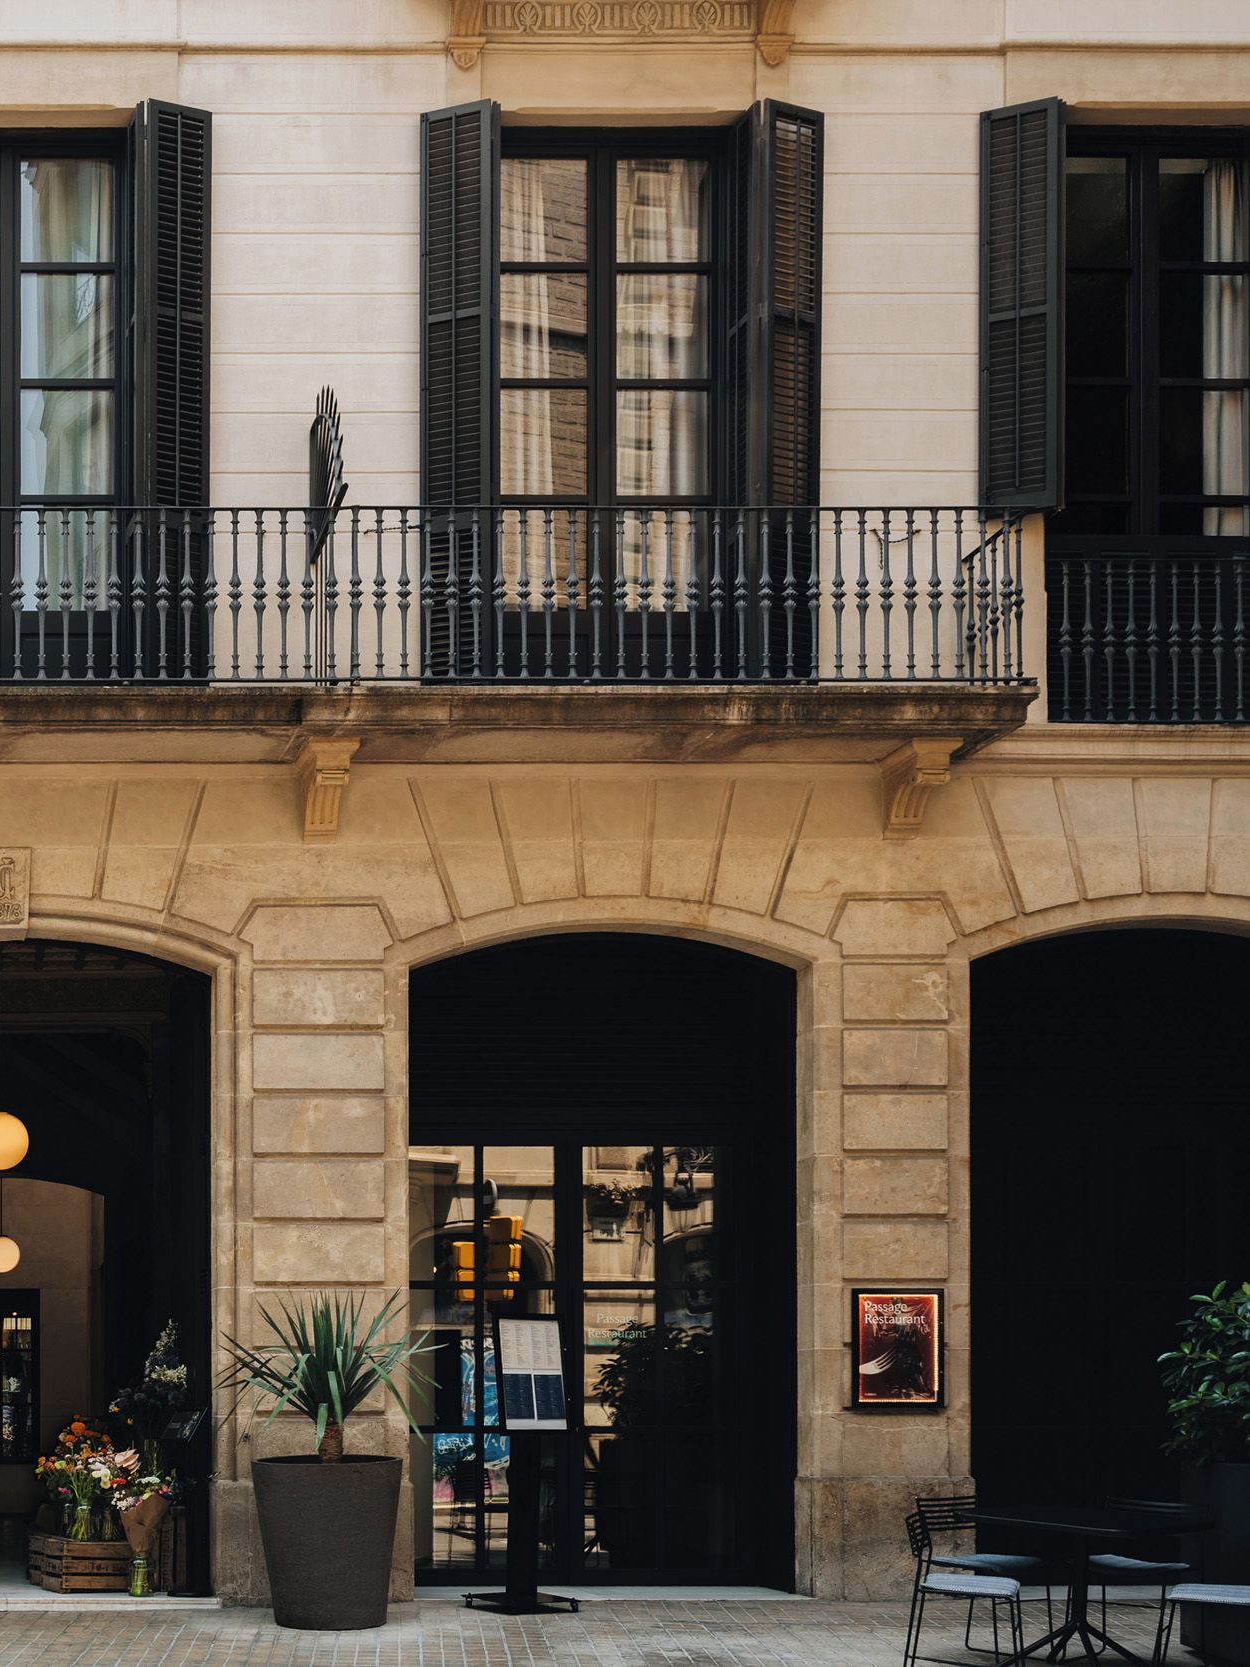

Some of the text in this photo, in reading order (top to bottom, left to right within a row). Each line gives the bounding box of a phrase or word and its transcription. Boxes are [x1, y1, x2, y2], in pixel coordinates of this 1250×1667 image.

[864, 1301, 908, 1314] Passage
[596, 1312, 639, 1326] Passage
[864, 1313, 926, 1325] Restaurant
[588, 1328, 647, 1339] Restaurant
